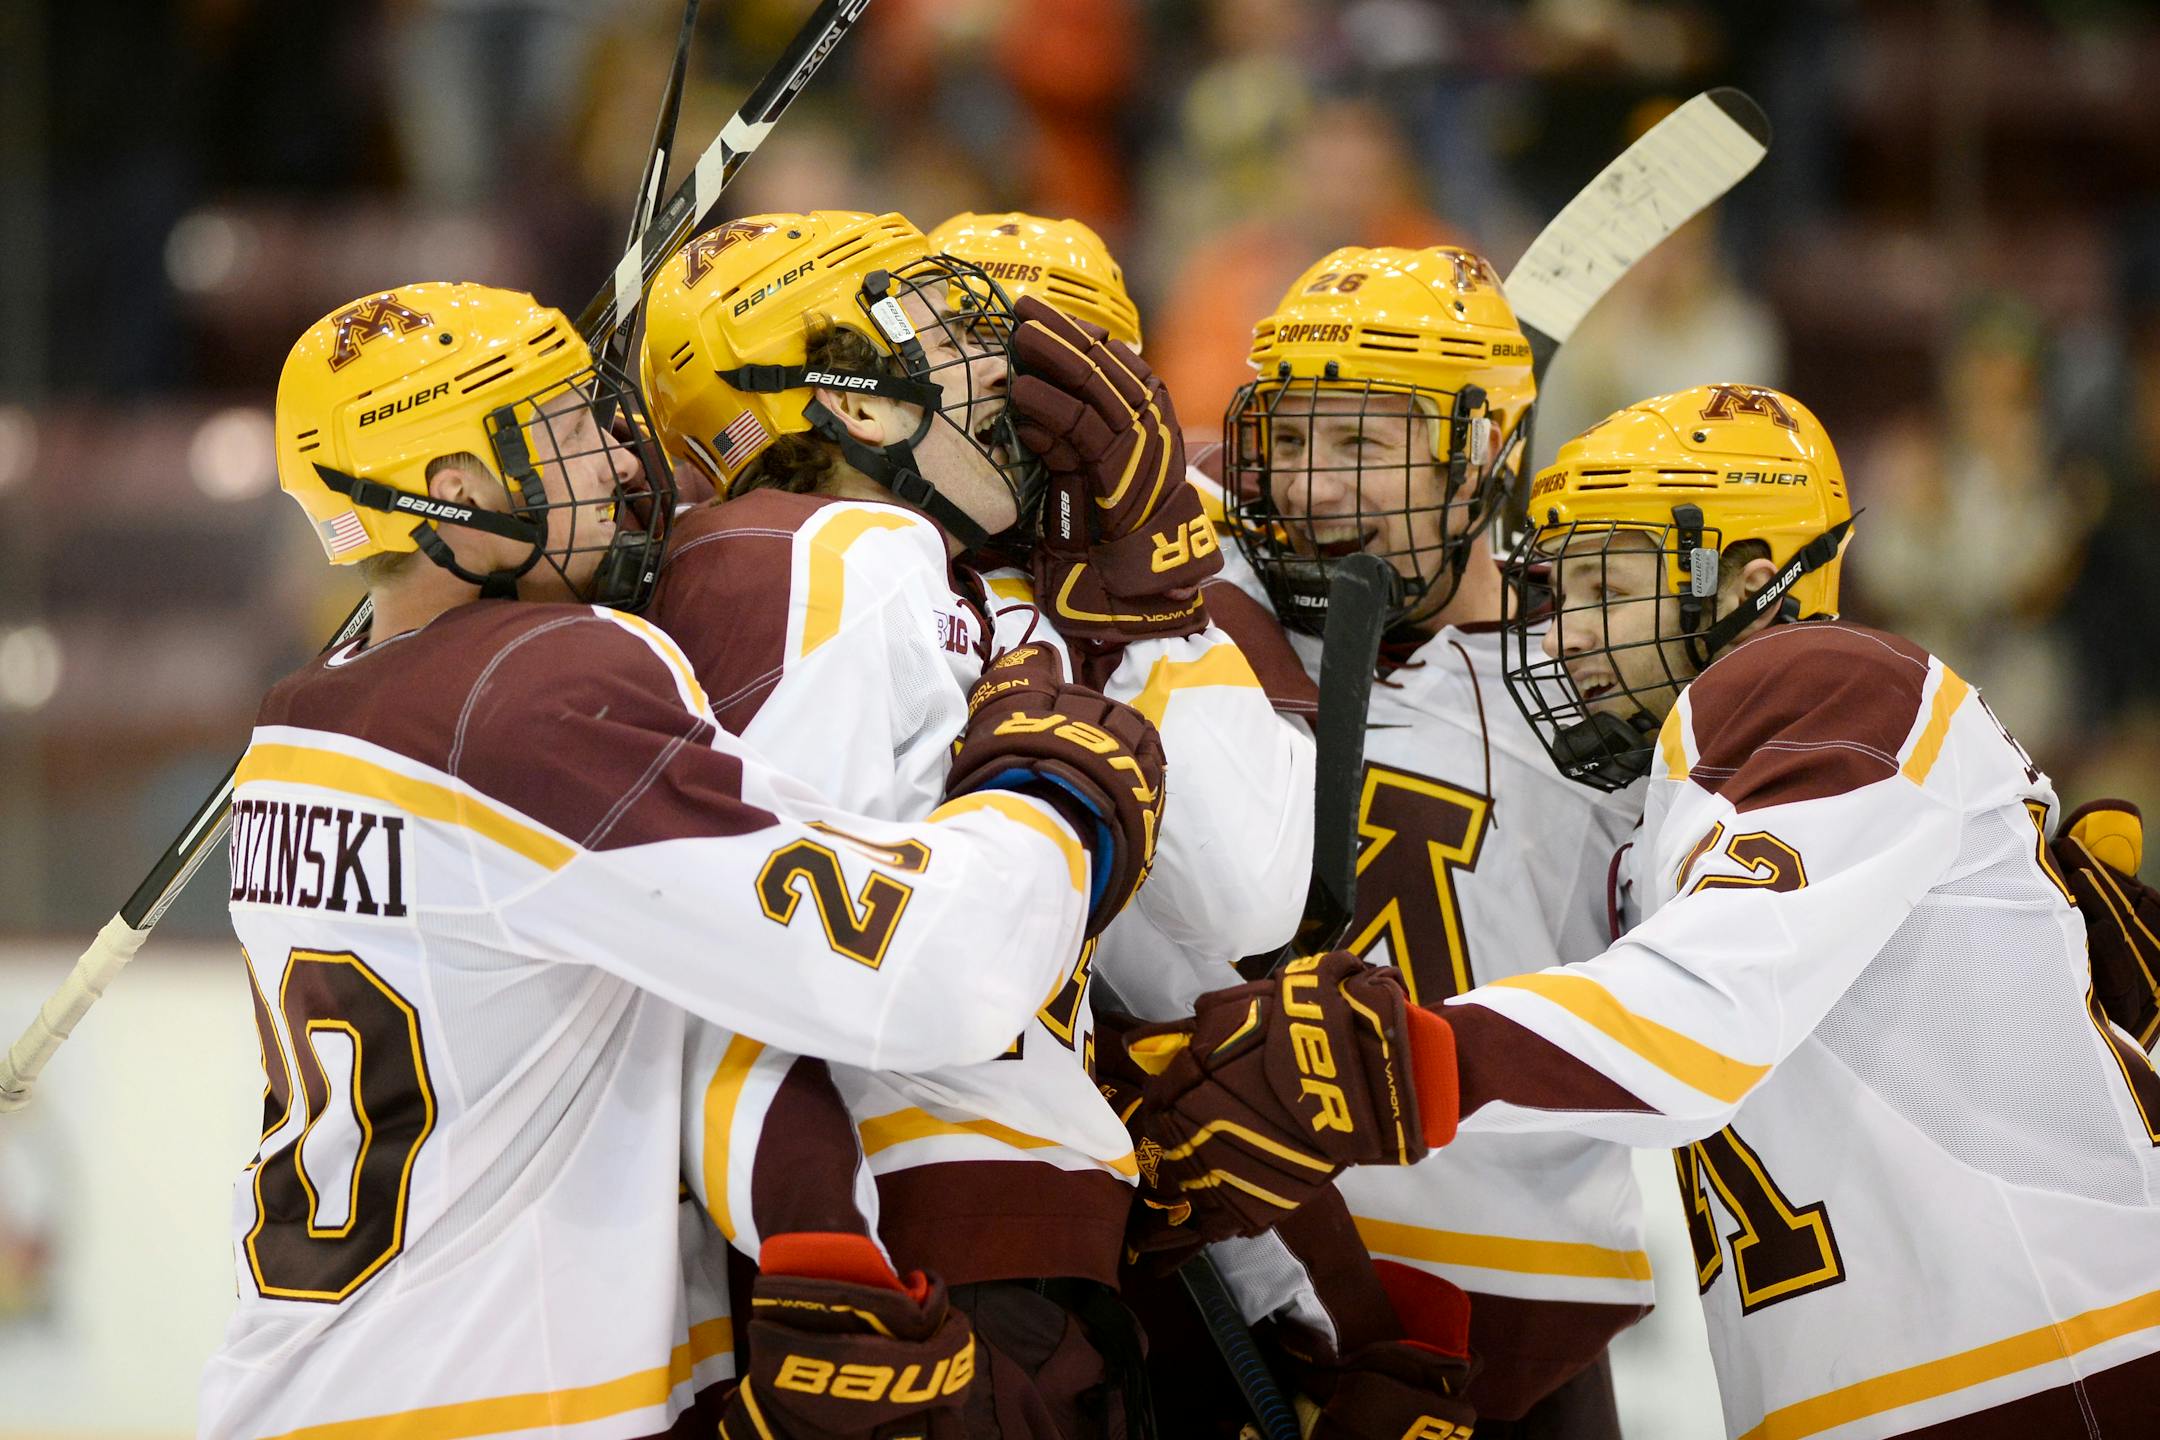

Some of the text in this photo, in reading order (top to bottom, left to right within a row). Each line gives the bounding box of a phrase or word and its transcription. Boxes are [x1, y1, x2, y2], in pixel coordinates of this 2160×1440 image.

[734, 260, 815, 318] BAUER
[1303, 273, 1368, 293] 26
[328, 293, 433, 373] M
[1277, 323, 1353, 343] GOPHERS
[359, 381, 450, 428] BAUER
[805, 370, 879, 391] BAUER
[1698, 384, 1801, 433] M
[1724, 471, 1808, 488] BAUER
[395, 494, 473, 522] BAUER
[1061, 490, 1071, 540] BAUER
[1756, 561, 1804, 613] BAUER
[232, 799, 407, 917] DZINSKI
[774, 1332, 976, 1403] BAUE
